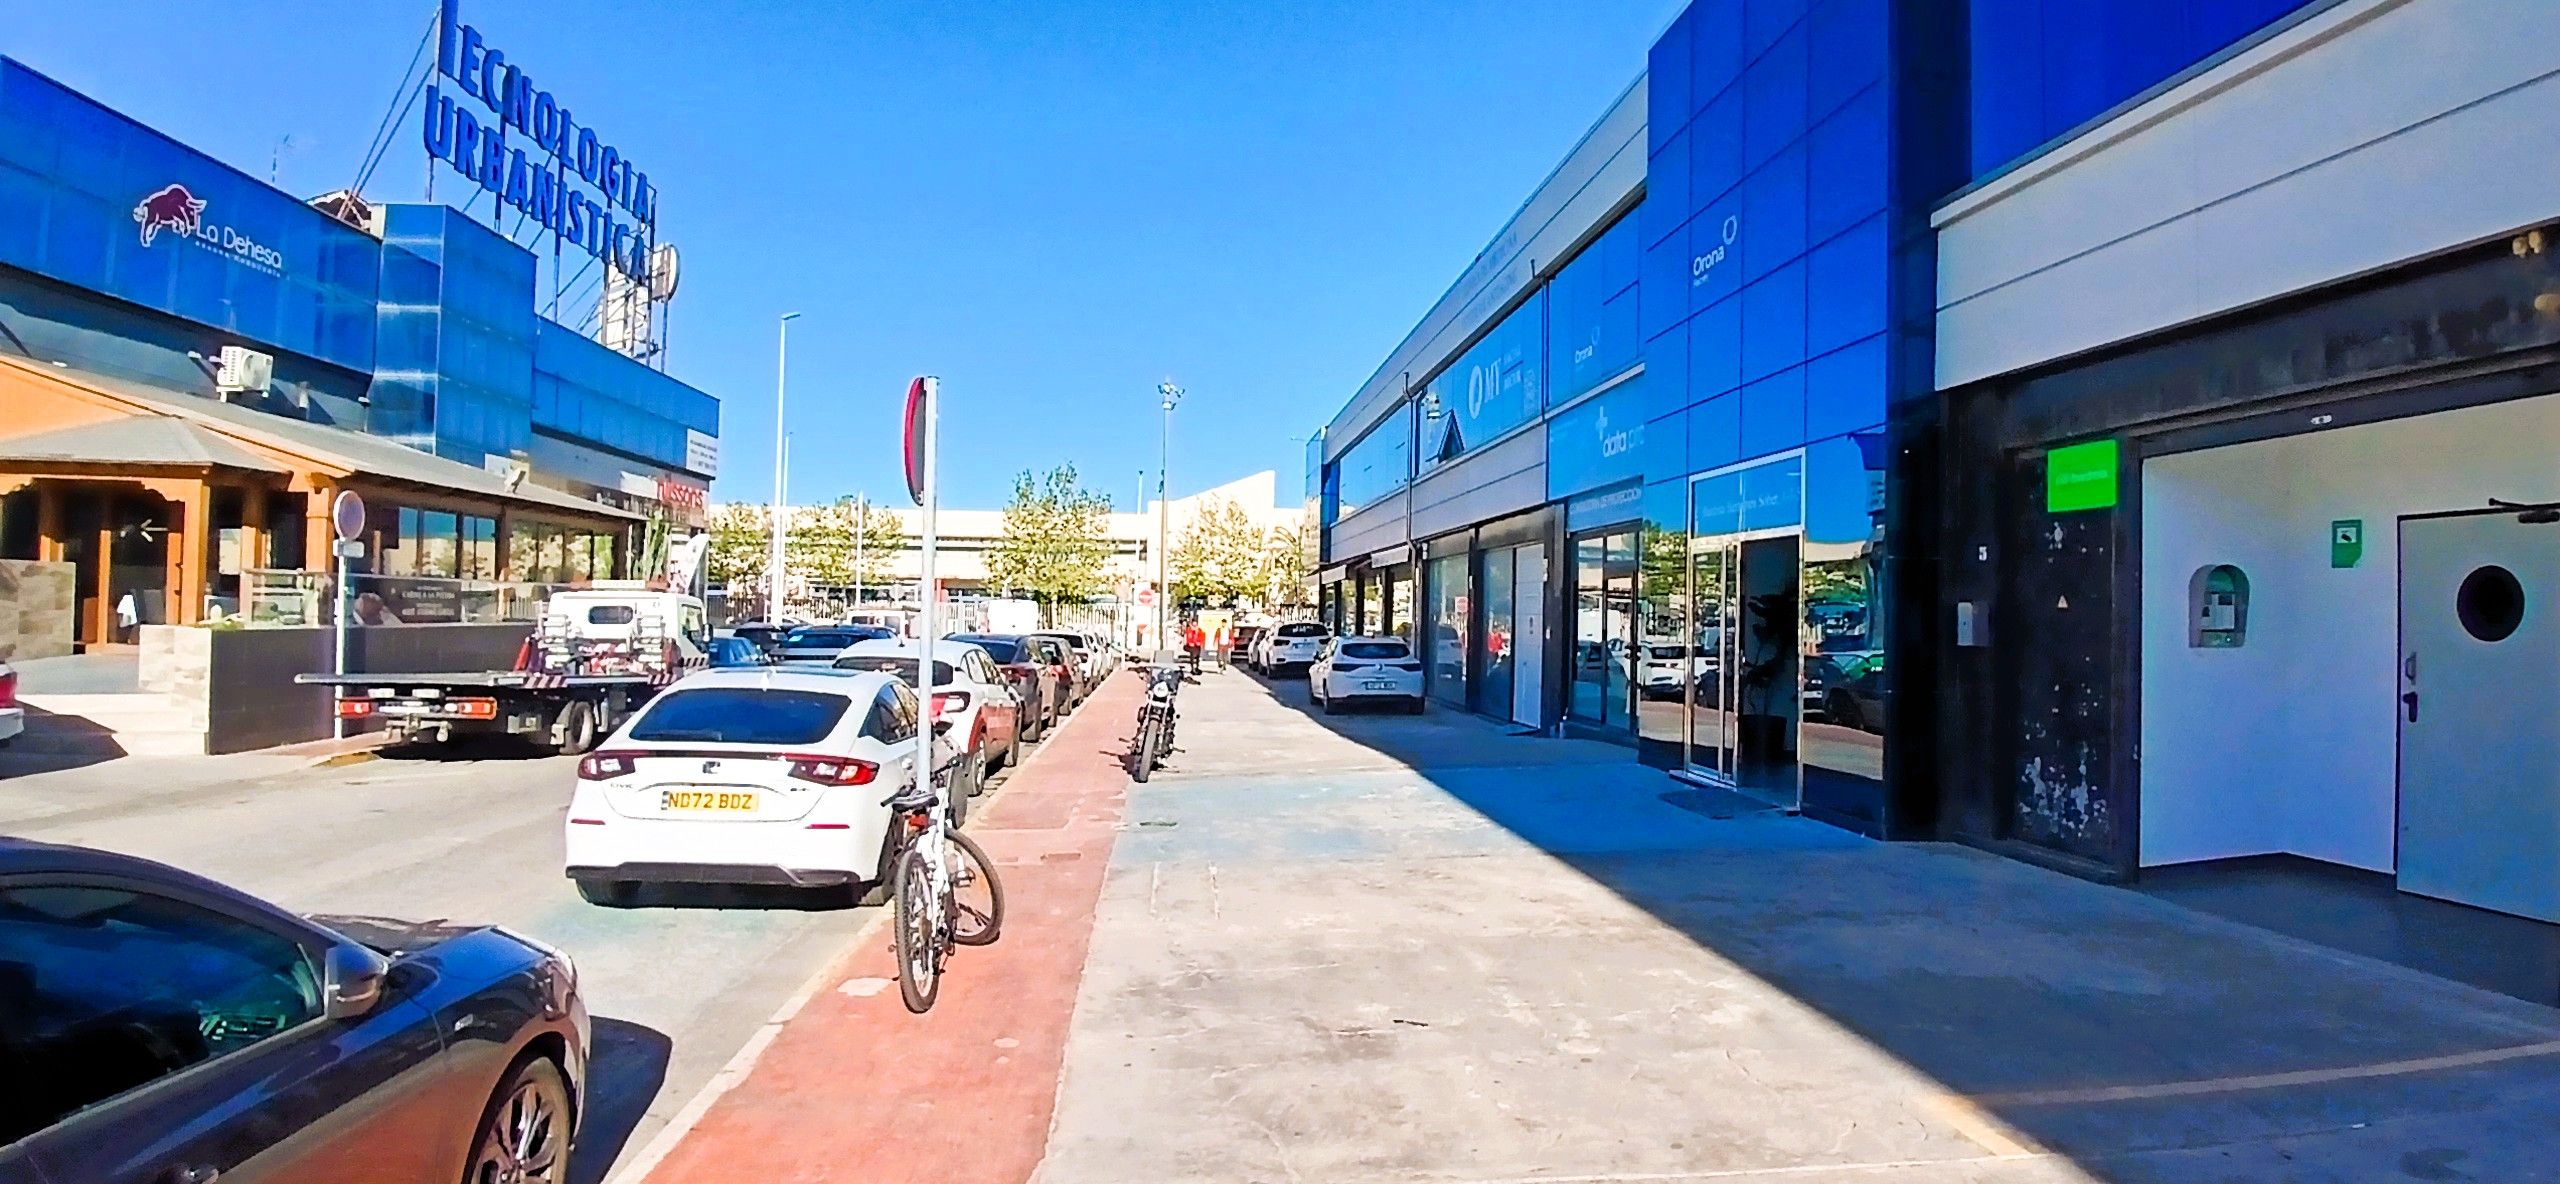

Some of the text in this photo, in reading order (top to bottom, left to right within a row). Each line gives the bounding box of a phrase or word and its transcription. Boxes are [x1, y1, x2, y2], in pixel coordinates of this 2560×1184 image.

[196, 215, 219, 243] La
[223, 226, 282, 269] Dehesa
[1693, 245, 1725, 276] Orona
[1602, 429, 1627, 458] data
[1978, 545, 1988, 561] 5
[668, 792, 753, 810] ND72 BDZ
